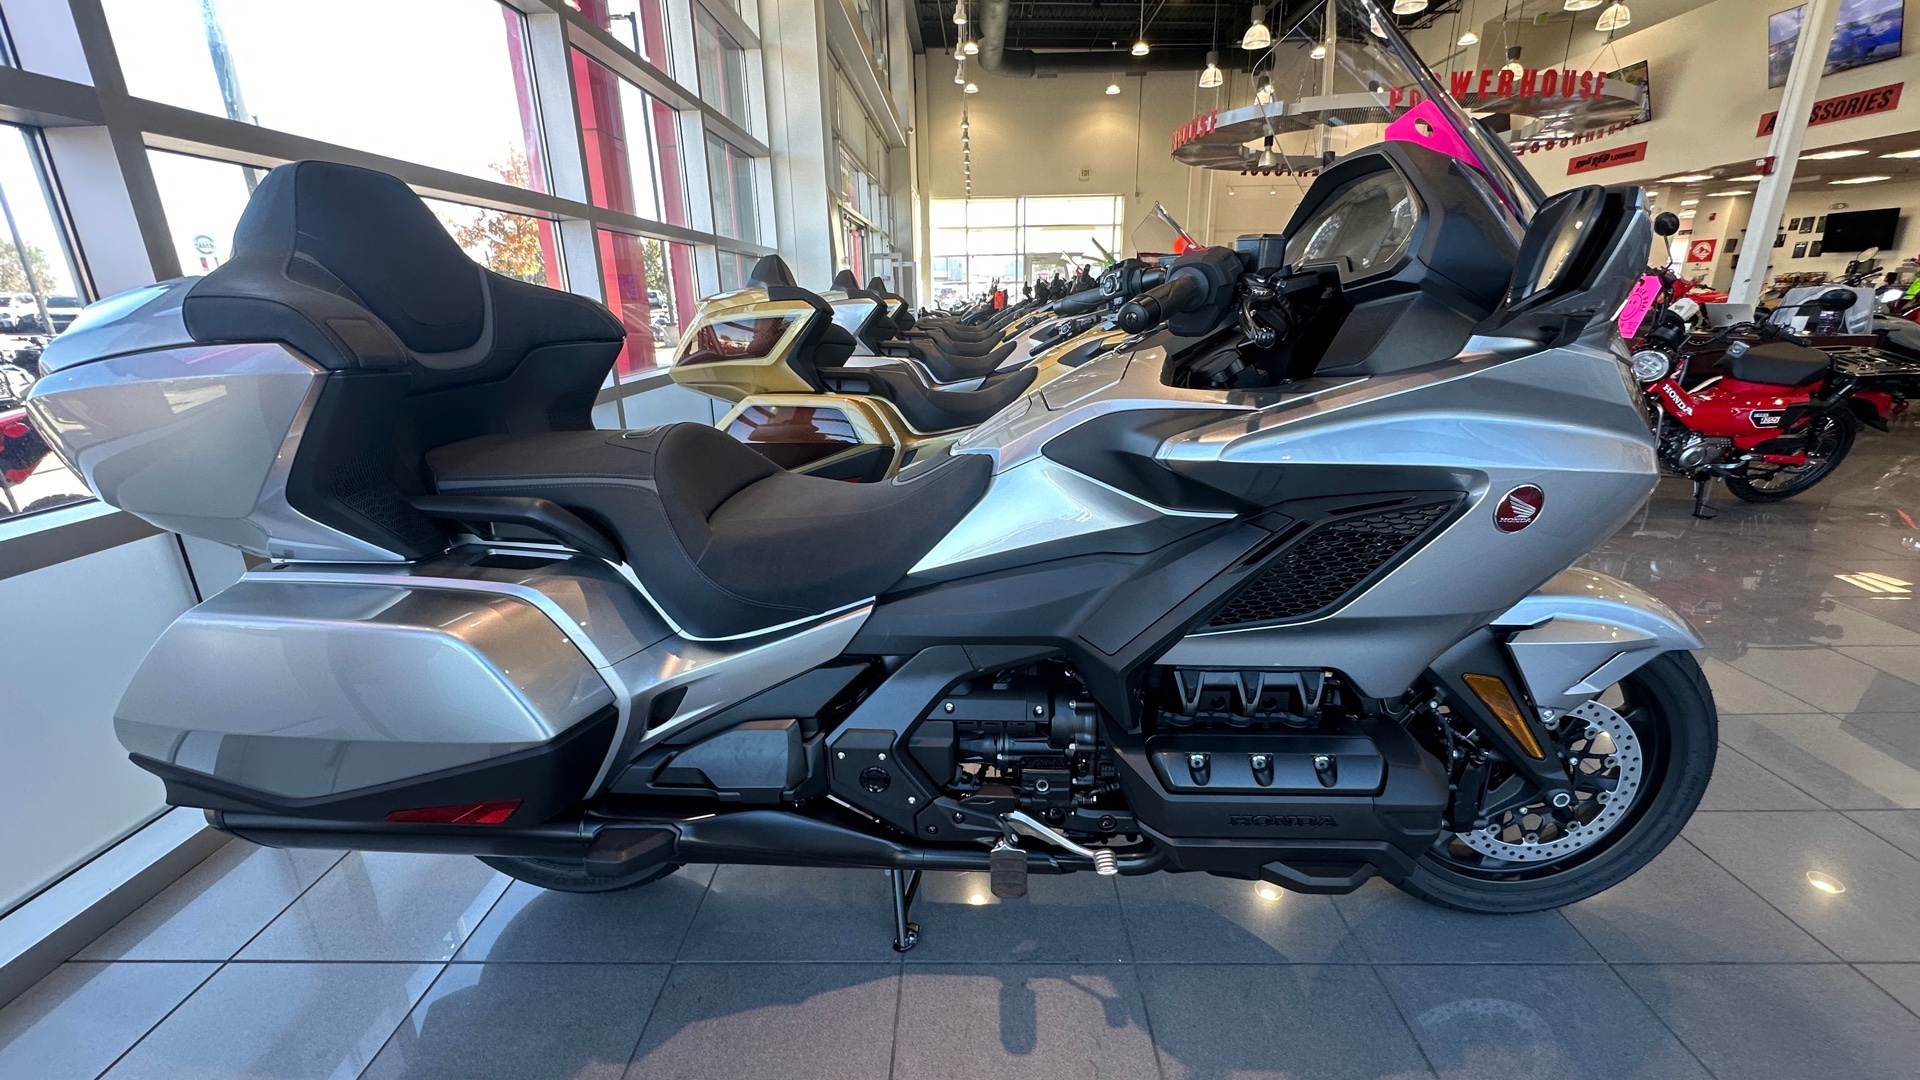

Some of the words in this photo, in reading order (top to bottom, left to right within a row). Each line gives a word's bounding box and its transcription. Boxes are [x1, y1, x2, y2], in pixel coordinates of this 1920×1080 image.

[1763, 89, 1894, 133] ASSORIES
[1662, 383, 1693, 416] HONDA
[1227, 814, 1338, 827] HONDA
